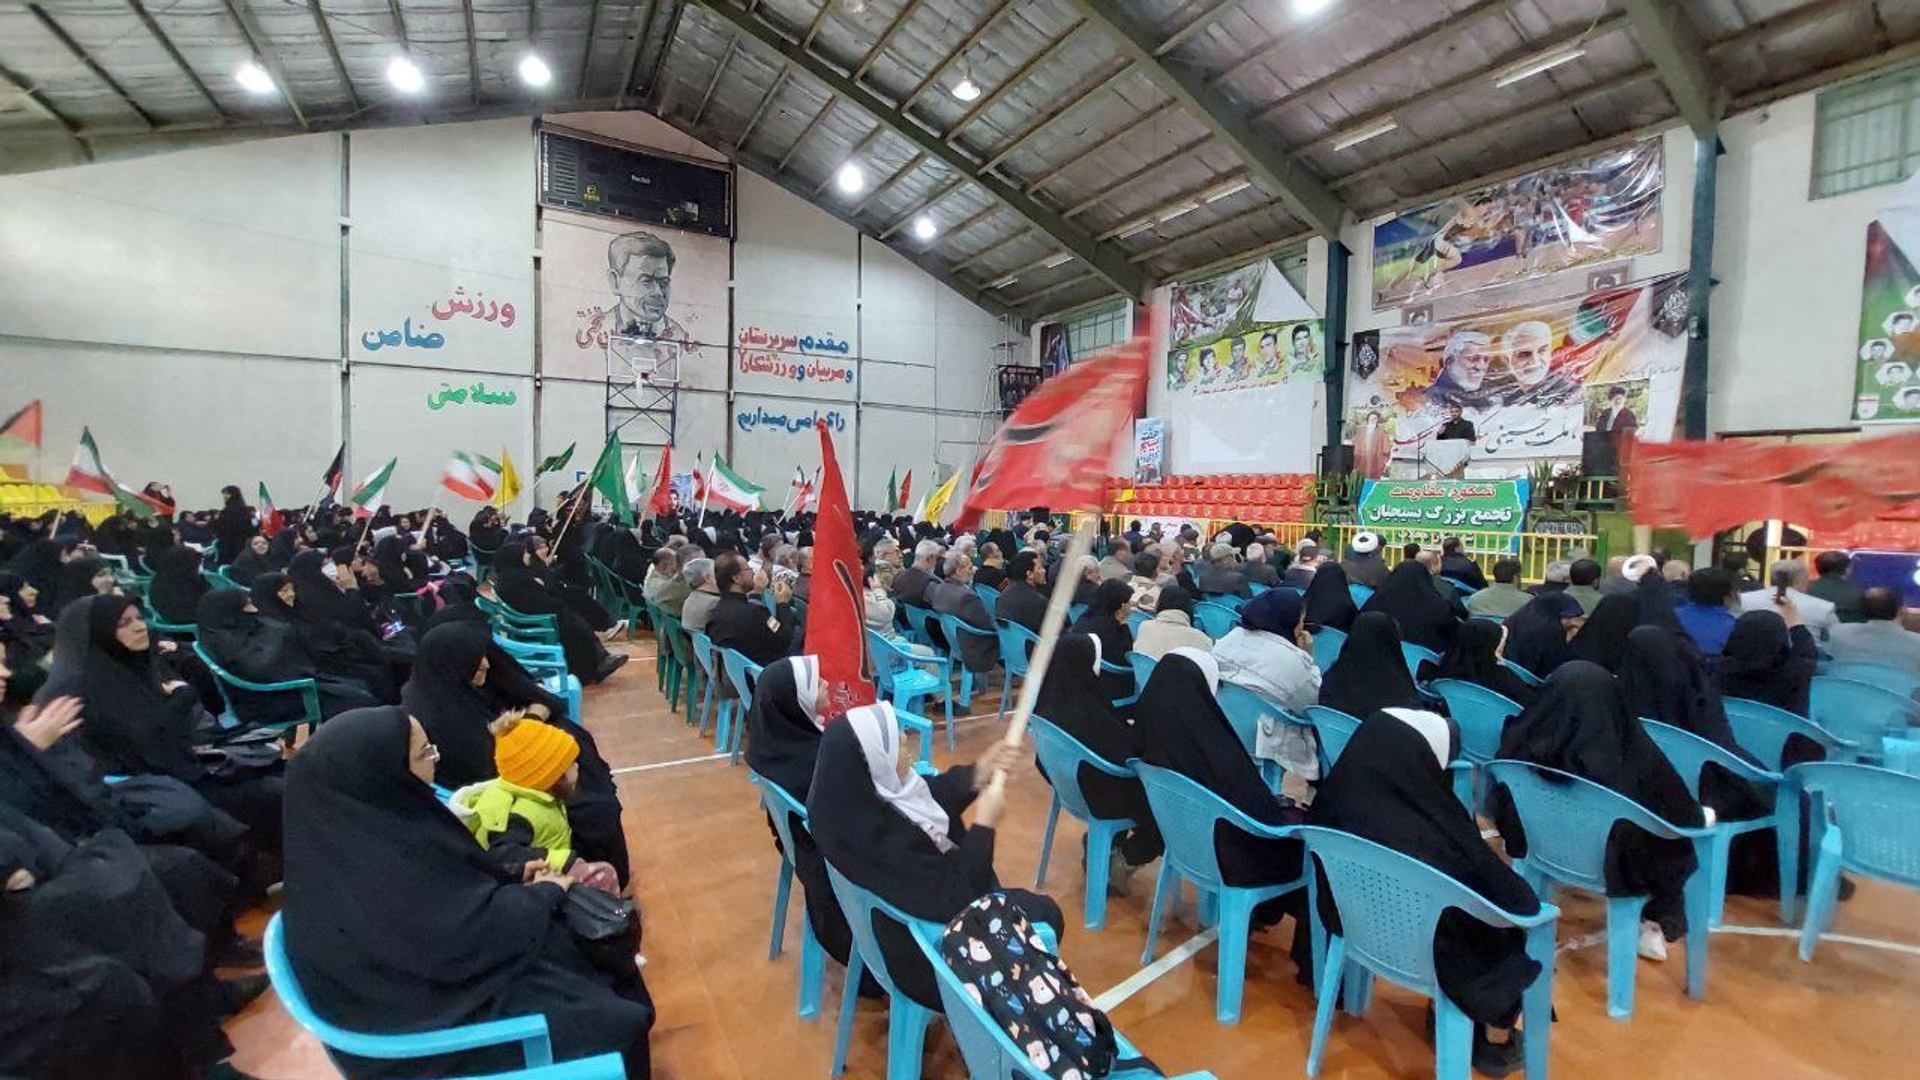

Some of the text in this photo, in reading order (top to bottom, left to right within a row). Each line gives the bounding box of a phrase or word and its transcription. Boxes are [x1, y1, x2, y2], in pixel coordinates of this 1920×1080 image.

[431, 286, 516, 328] ورزش
[361, 316, 446, 351] ضامن
[799, 331, 849, 354] مقدم
[427, 382, 517, 411] سلامتی
[1424, 506, 1468, 527] بزرگ
[1469, 506, 1513, 526] تجمع
